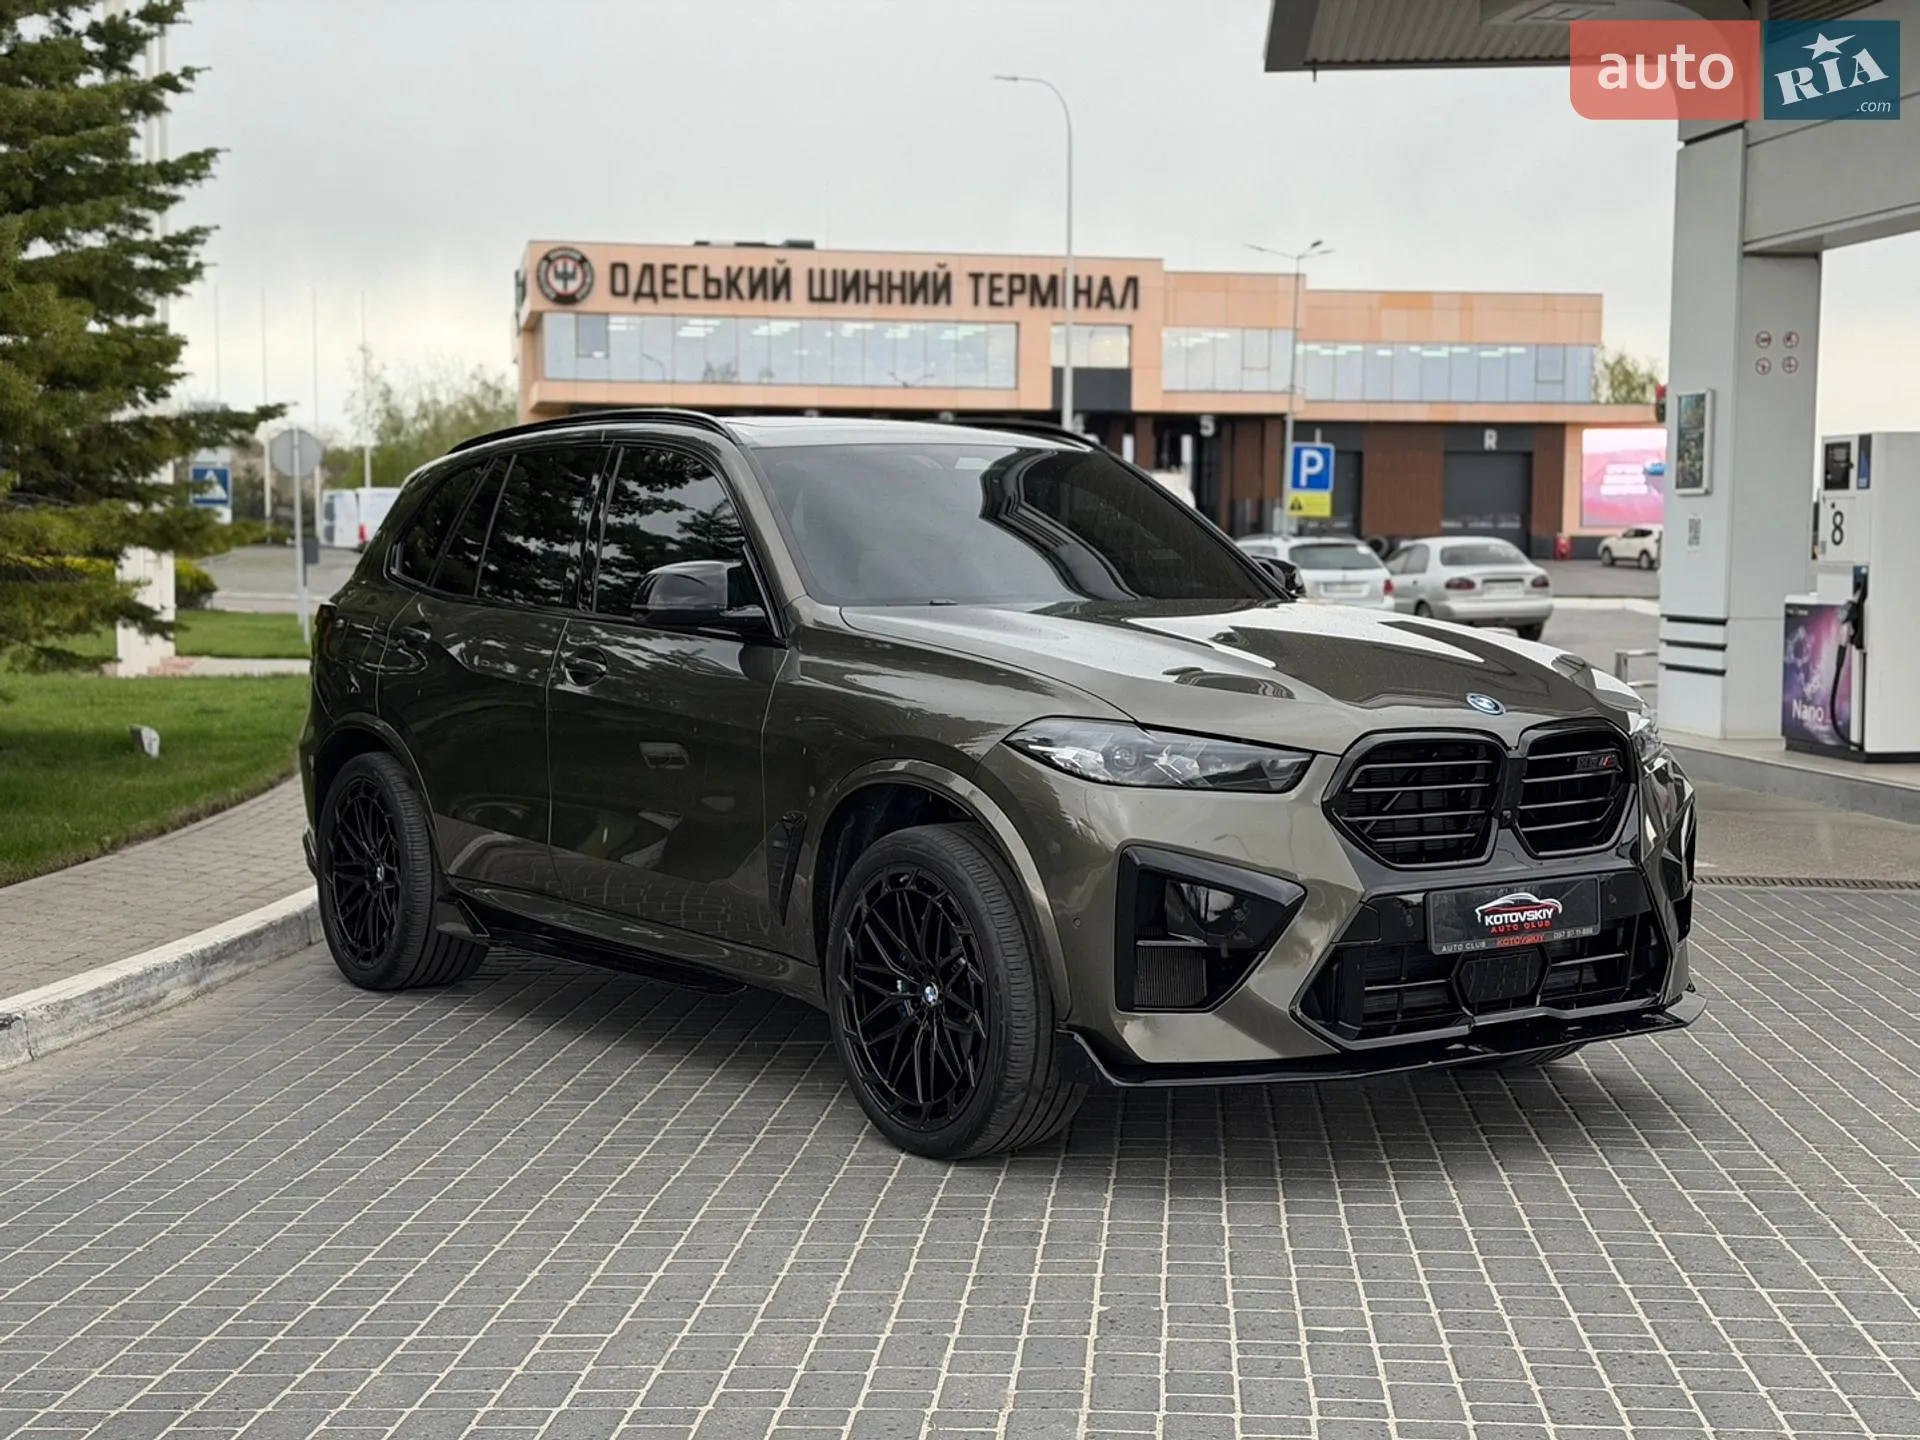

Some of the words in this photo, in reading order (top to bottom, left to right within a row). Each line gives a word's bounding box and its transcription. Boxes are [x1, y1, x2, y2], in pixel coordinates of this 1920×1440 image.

[609, 257, 791, 304] ОДЕСЬКИЙ
[807, 262, 952, 307] ШИННИЙ
[1483, 429, 1497, 451] R
[1299, 448, 1324, 488] P
[1831, 510, 1844, 546] 8
[1792, 698, 1824, 721] Nano
[1485, 908, 1553, 926] KOTOVSKIY
[1490, 923, 1519, 934] AUTO
[1523, 920, 1551, 929] CLUB
[1441, 943, 1463, 953] AUTO
[1465, 941, 1486, 950] CLUB
